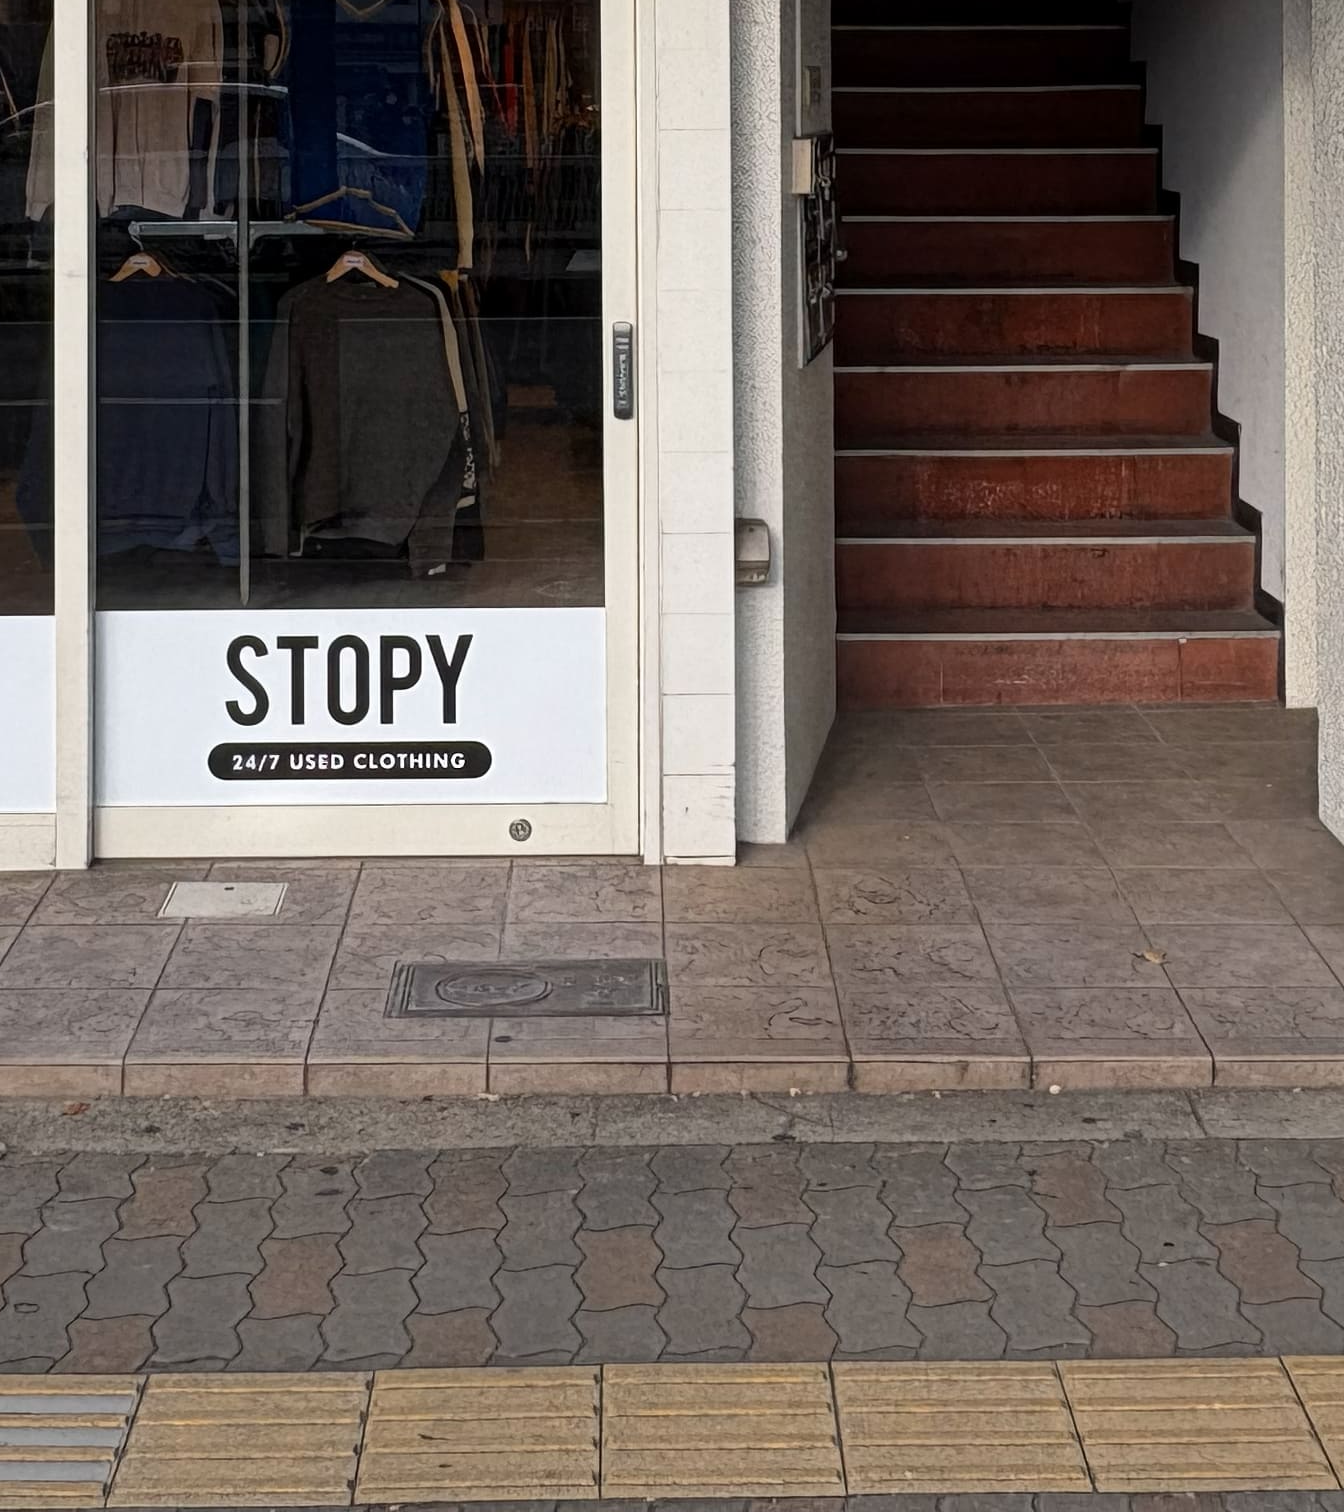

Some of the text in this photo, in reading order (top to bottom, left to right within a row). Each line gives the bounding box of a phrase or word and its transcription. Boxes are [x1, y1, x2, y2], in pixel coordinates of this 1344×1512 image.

[225, 634, 474, 727] STOPY
[230, 748, 465, 772] 24/7 USED CLOTHING
